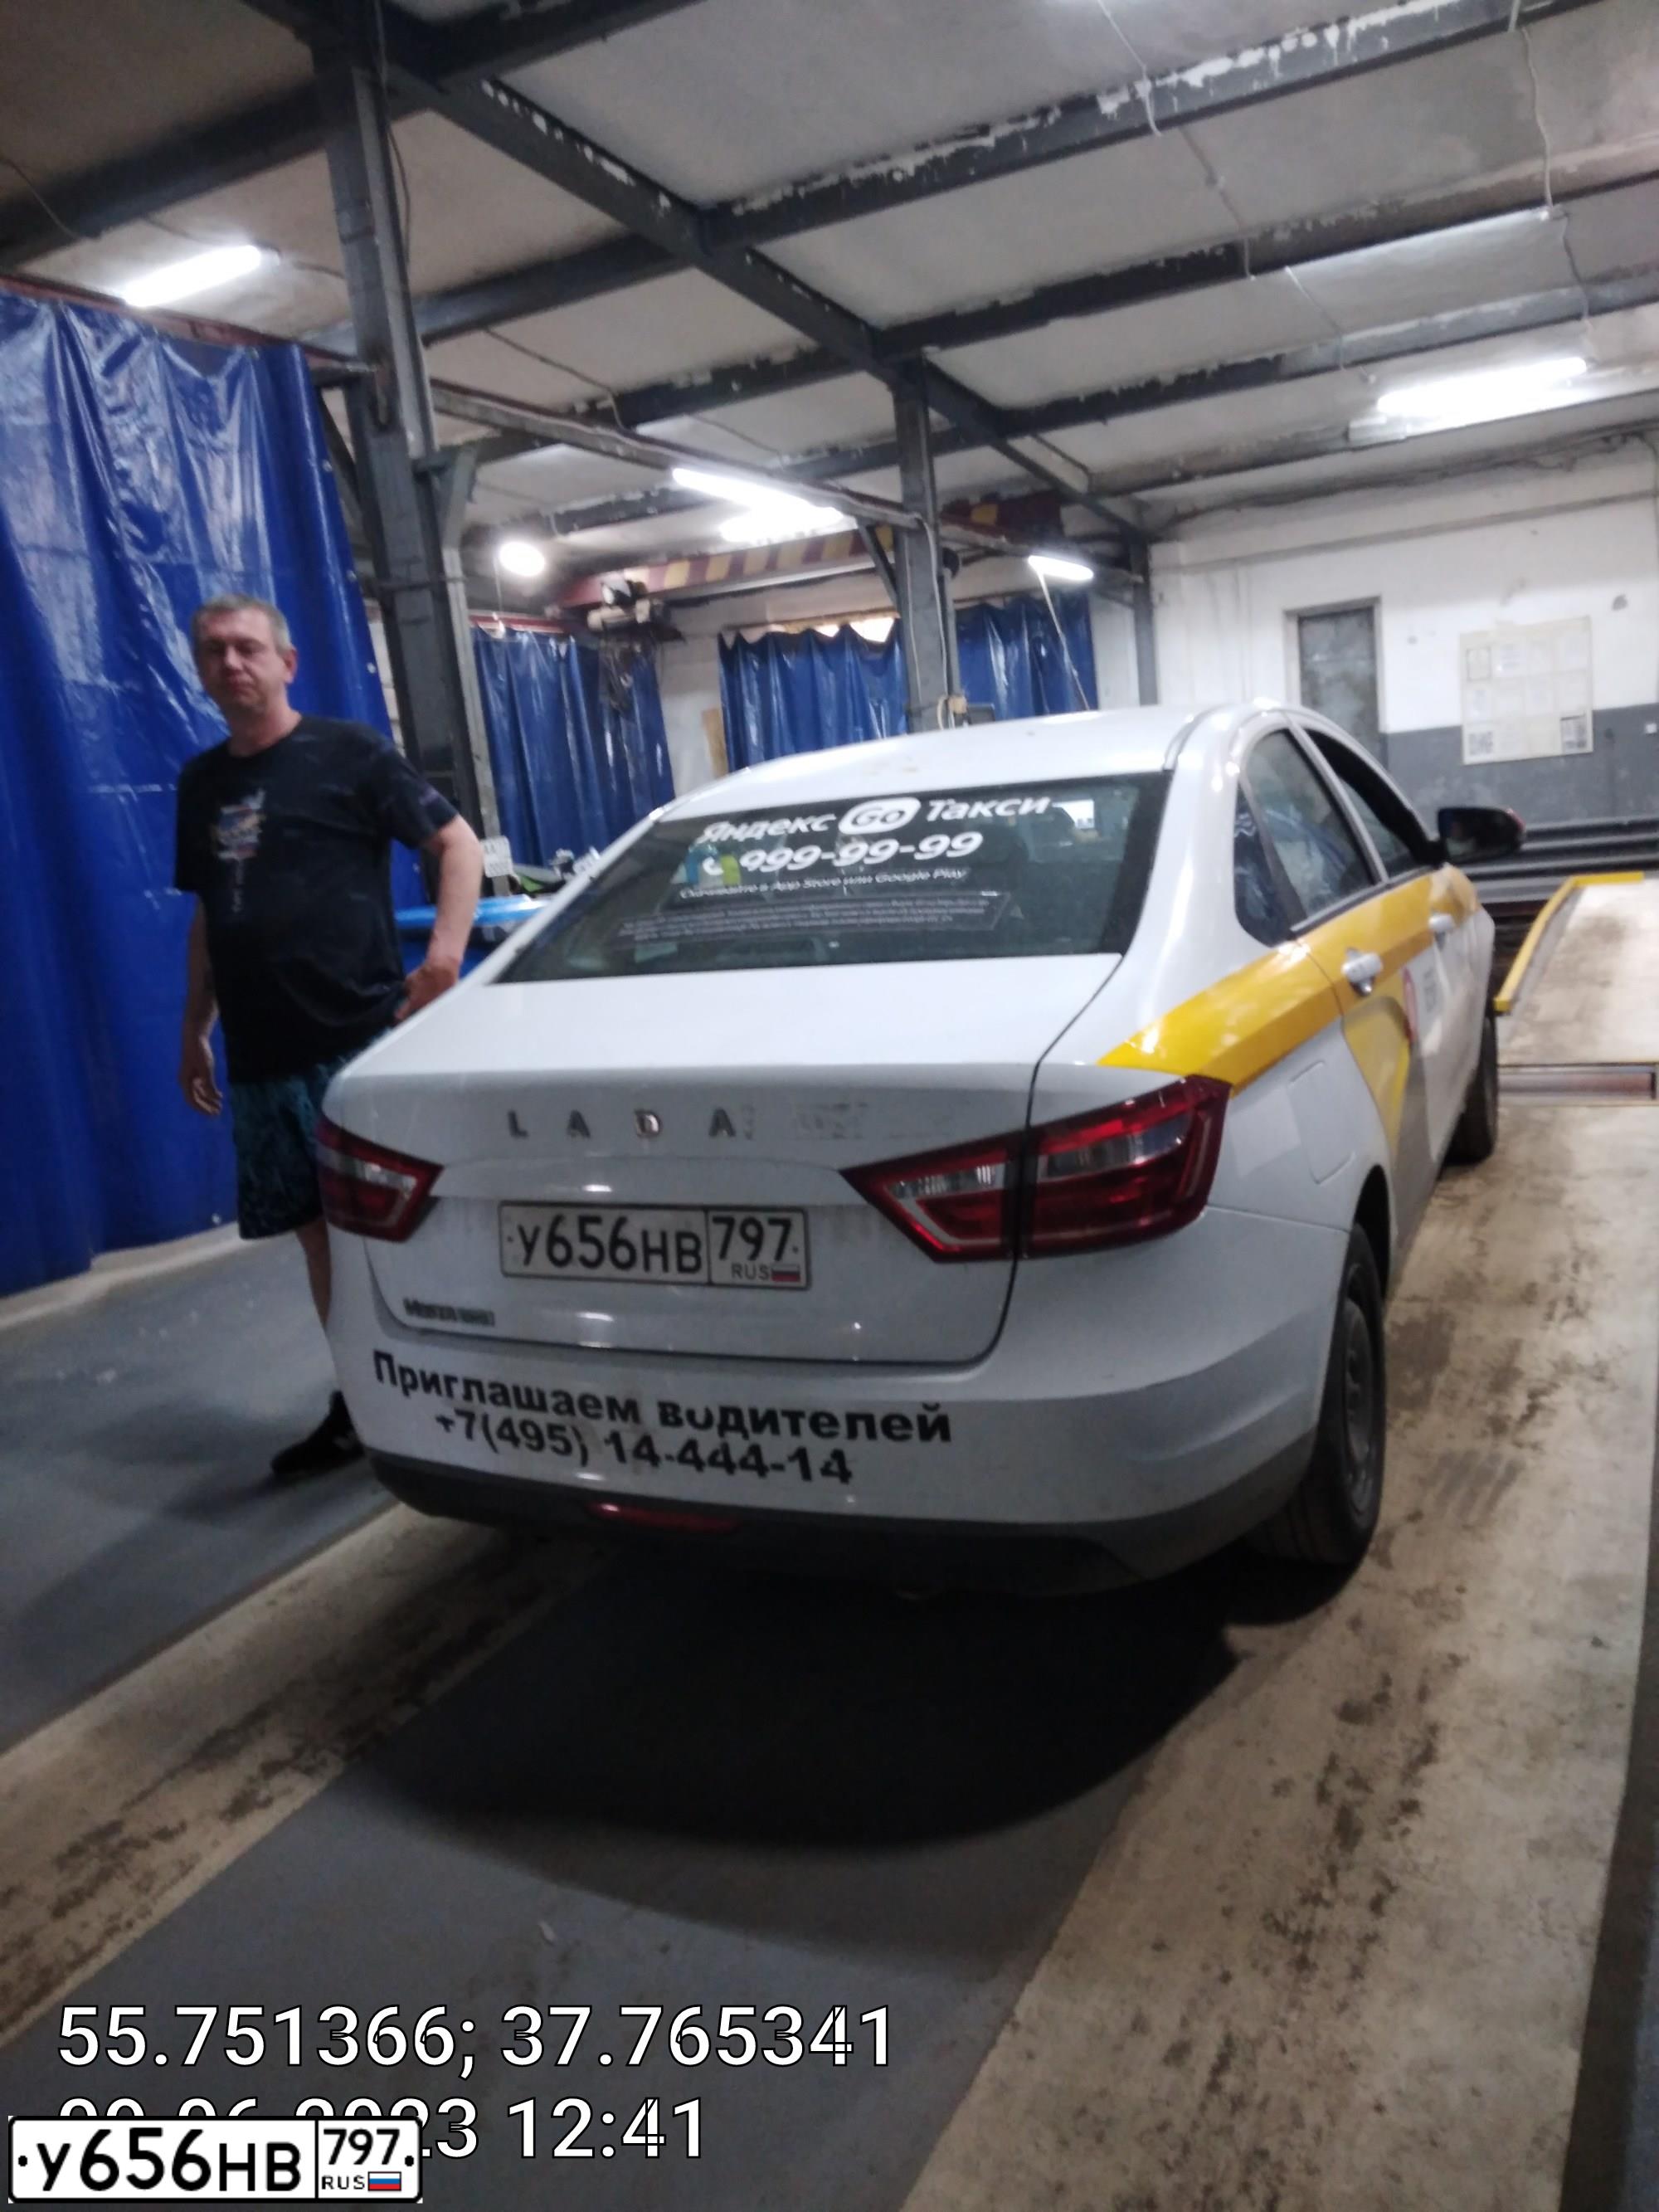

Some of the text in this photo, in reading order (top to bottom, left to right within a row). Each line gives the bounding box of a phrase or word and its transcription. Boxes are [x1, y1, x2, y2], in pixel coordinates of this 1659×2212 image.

[697, 812, 836, 844] Яндекс
[926, 797, 1051, 821] Такси
[739, 831, 984, 873] 999-99-99
[875, 870, 931, 884] Google
[507, 1108, 737, 1140] LADA
[712, 1216, 792, 1262] 797
[731, 1264, 770, 1281] RUS
[373, 1350, 952, 1444] Приглашаем водителей
[435, 1408, 854, 1485] +7(495) 14-444-14
